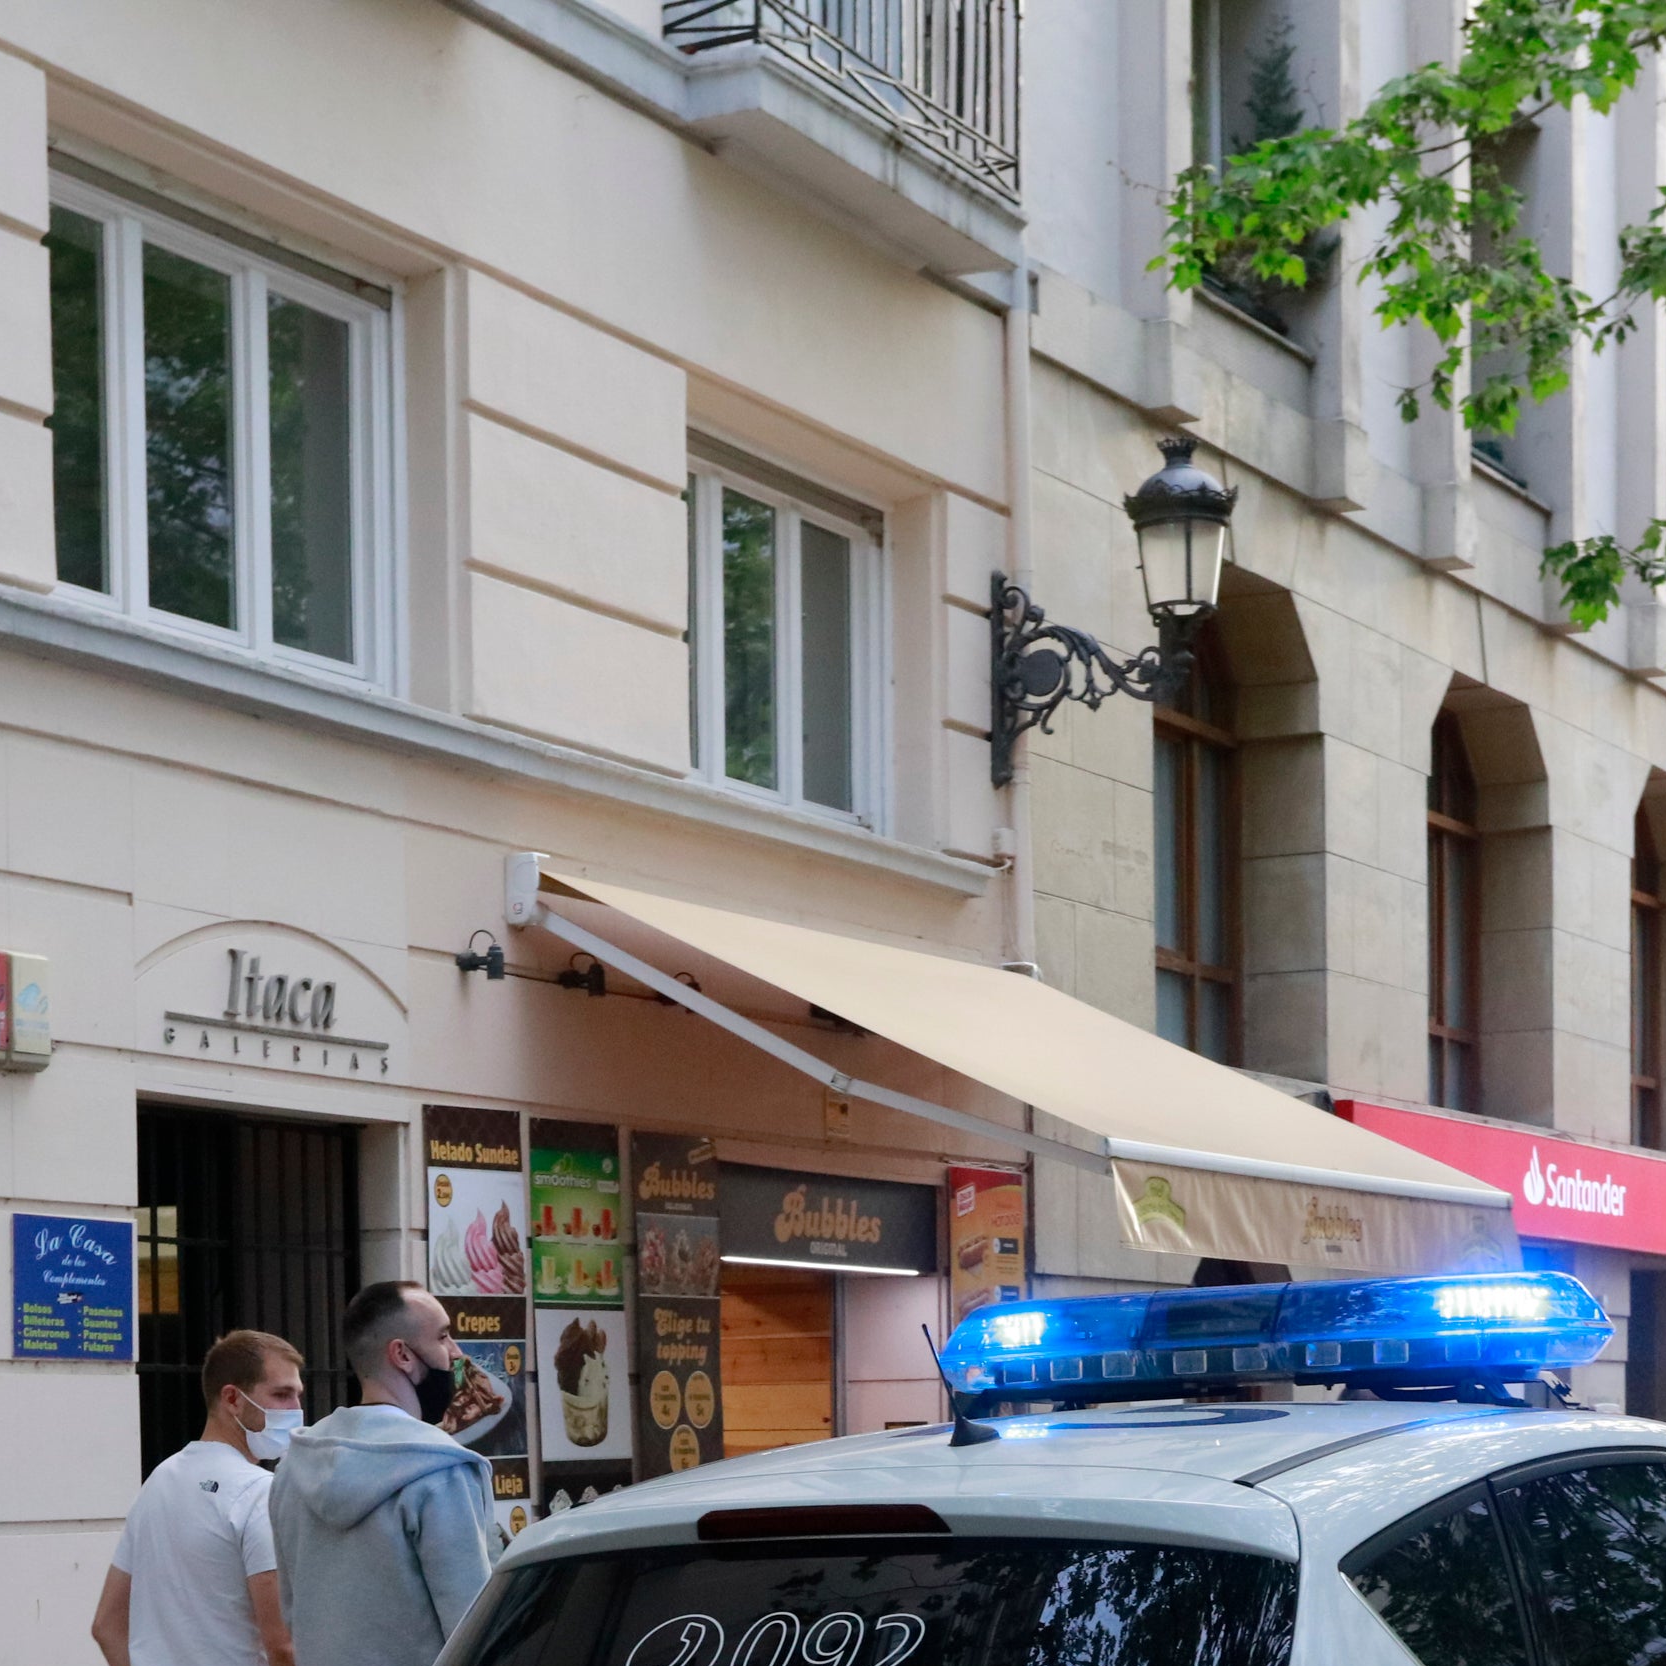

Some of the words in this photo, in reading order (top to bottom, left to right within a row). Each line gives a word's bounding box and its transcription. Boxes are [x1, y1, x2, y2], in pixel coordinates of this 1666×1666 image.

[223, 948, 337, 1030] Itaca
[163, 1027, 389, 1074] GALERIAS
[429, 1139, 473, 1163] Helado
[475, 1143, 519, 1166] Sundae
[638, 1161, 715, 1200] Bubbles
[1546, 1163, 1627, 1217] Santander
[774, 1183, 882, 1244] Bubbles
[34, 1228, 63, 1261] La
[69, 1224, 118, 1266] Casa
[61, 1254, 73, 1267] de
[22, 1303, 52, 1315] Bolsos
[457, 1311, 501, 1334] Crepes
[83, 1318, 118, 1330] Guantes
[83, 1330, 123, 1342] Paraguas
[653, 1308, 693, 1339] Elige
[696, 1316, 711, 1333] tu
[22, 1339, 58, 1351] Maletas
[83, 1341, 115, 1353] Fulares
[656, 1339, 709, 1367] topping
[494, 1474, 524, 1496] Lieja
